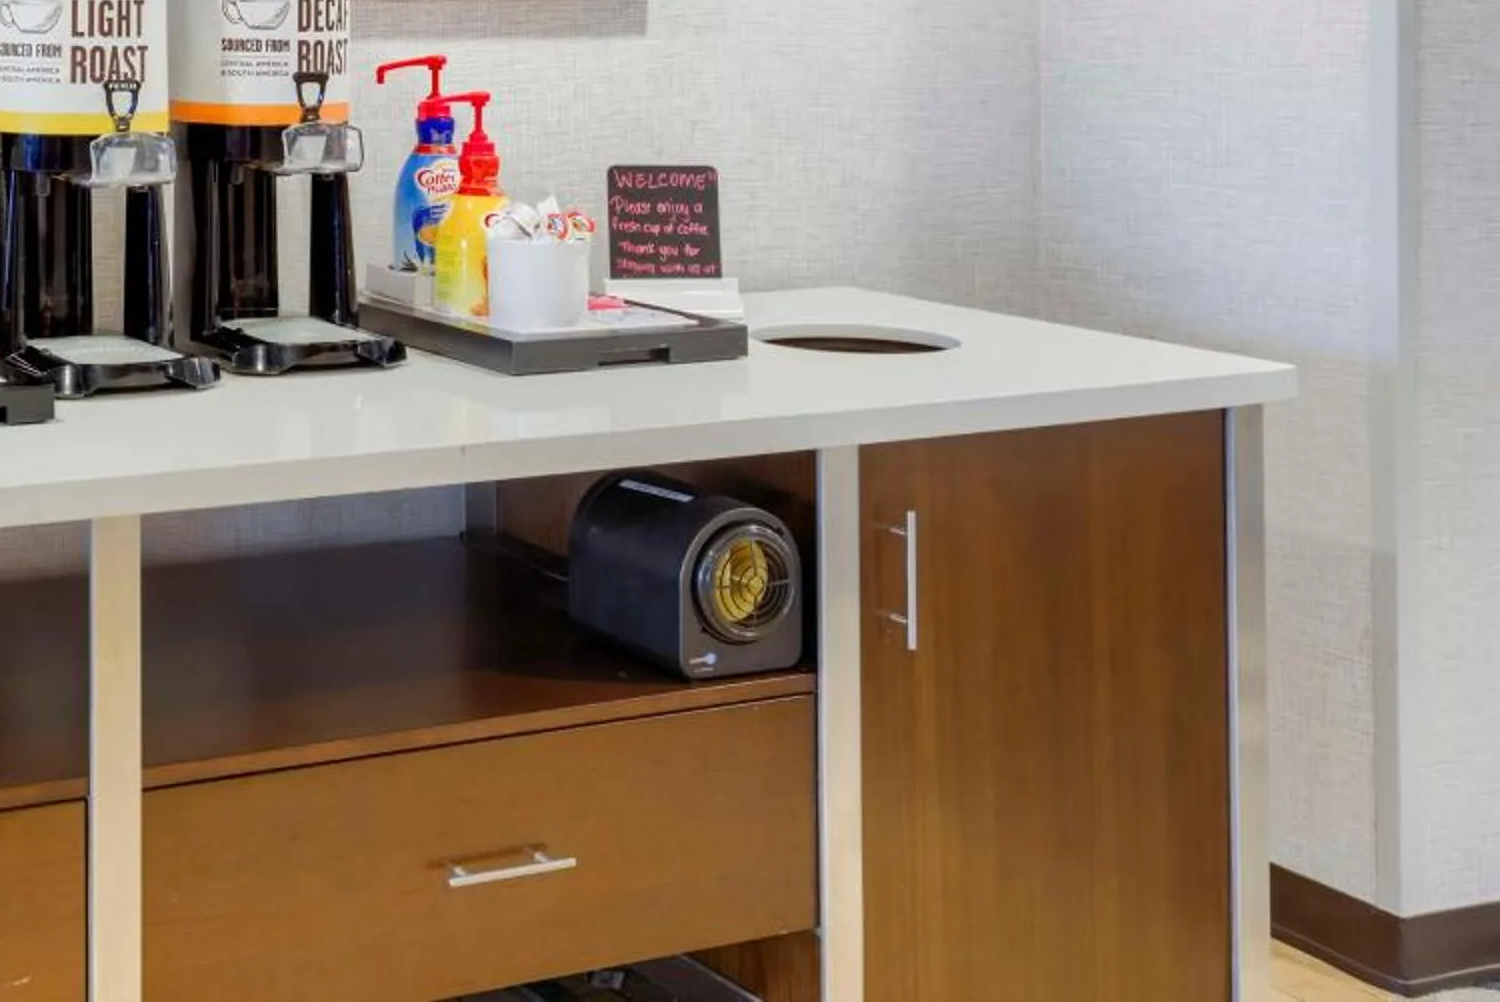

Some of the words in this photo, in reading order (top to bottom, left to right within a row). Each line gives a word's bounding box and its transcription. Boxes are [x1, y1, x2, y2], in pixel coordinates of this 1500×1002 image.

[71, 0, 145, 38] LIGHT
[35, 43, 62, 58] FROM
[221, 38, 262, 52] SOURCED
[265, 40, 290, 52] FROM
[297, 39, 348, 75] ROAST
[70, 45, 149, 84] ROAST
[610, 195, 652, 215] Please
[656, 198, 690, 223] enjoy
[693, 202, 703, 214] a
[611, 215, 640, 232] fresh
[643, 223, 660, 236] cup
[663, 221, 674, 233] of
[618, 240, 655, 254] Thank
[659, 244, 679, 262] you
[684, 242, 700, 256] for
